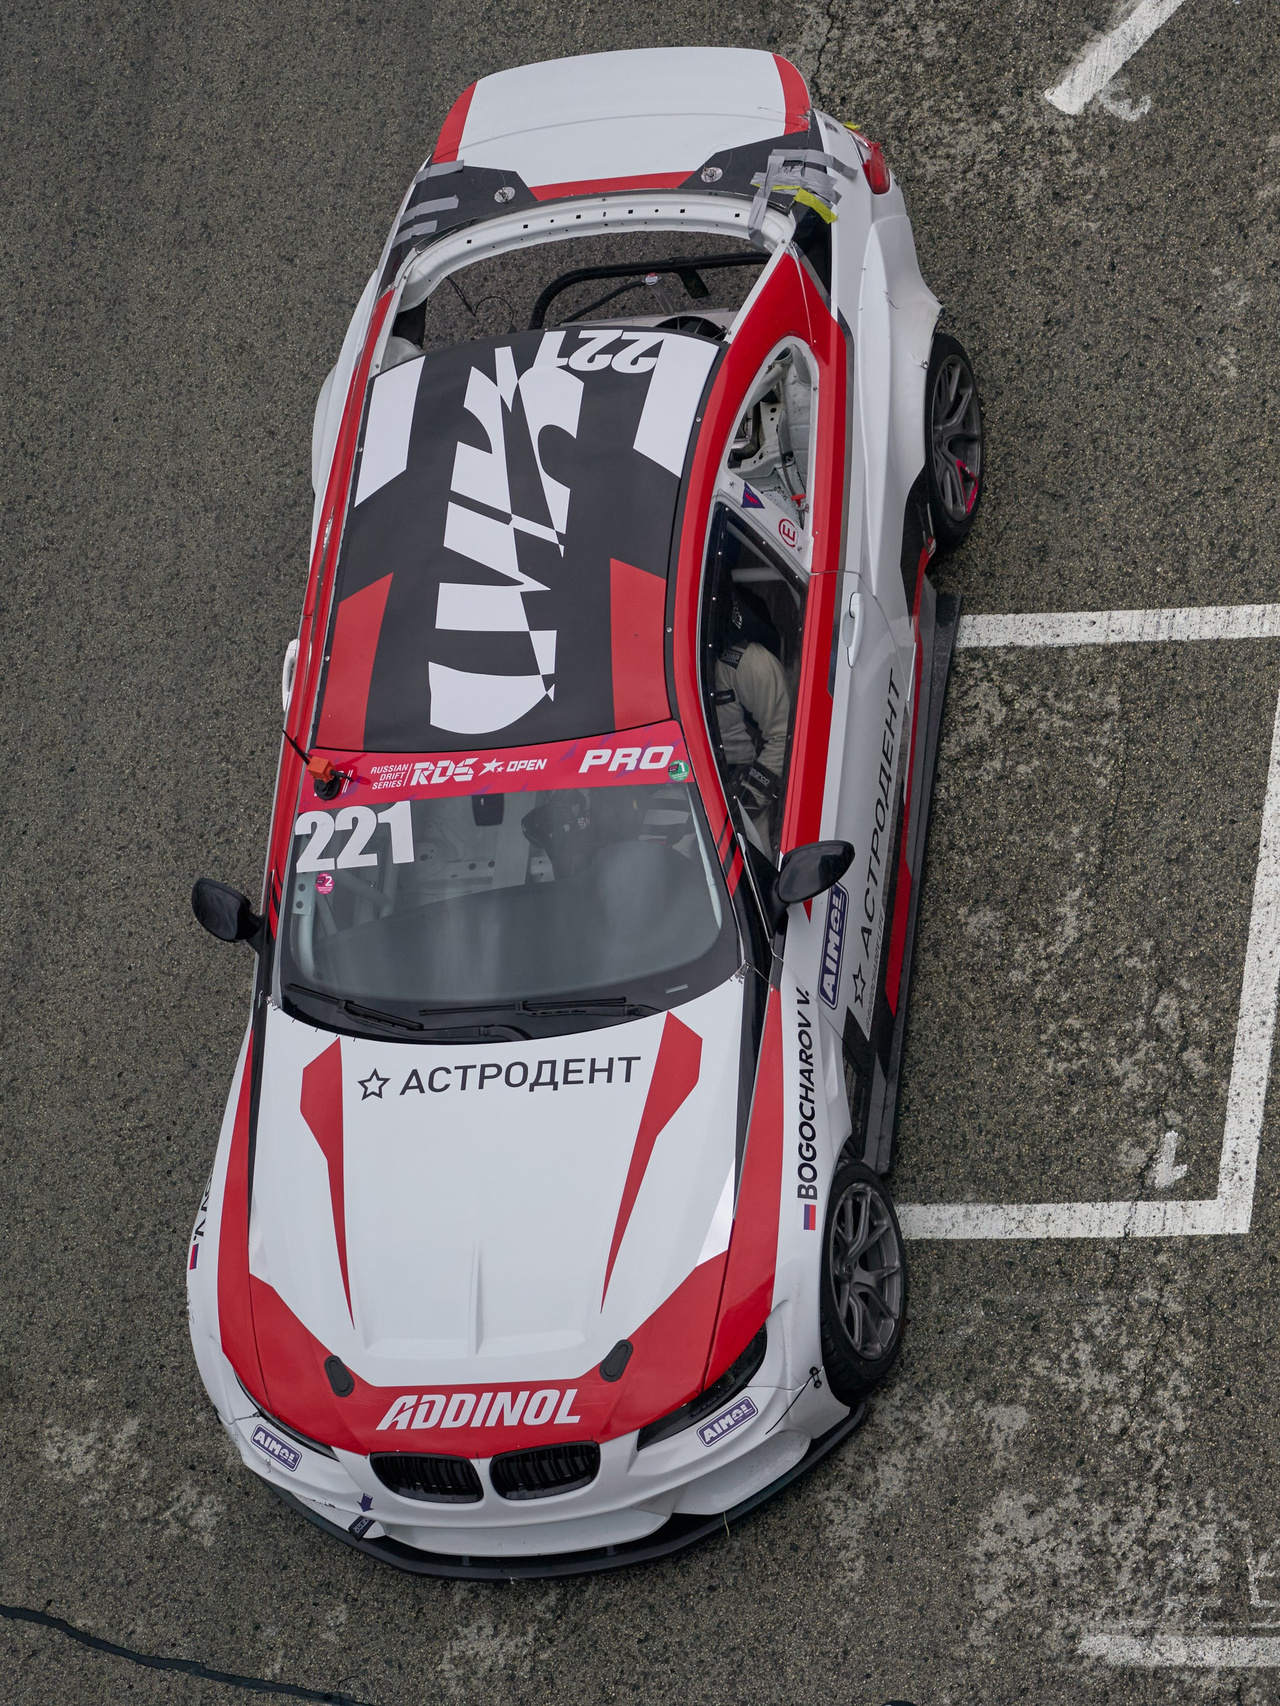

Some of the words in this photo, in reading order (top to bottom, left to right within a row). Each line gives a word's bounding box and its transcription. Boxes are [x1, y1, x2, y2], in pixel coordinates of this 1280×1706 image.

[533, 329, 665, 374] 221
[371, 764, 409, 774] RUSSIAN
[380, 772, 405, 781] DRIFT
[506, 758, 547, 773] OPEN
[578, 745, 674, 774] PRO
[372, 780, 402, 790] SERIES
[861, 667, 900, 959] АСТРОДЕНТ
[295, 800, 415, 873] 221
[821, 892, 844, 1002] AIMOL
[795, 986, 811, 1006] V.
[400, 1056, 641, 1096] АСТРОДЕНТ
[797, 1010, 819, 1200] BOGOCHAROV
[376, 1389, 581, 1431] ADDINOL
[703, 1401, 753, 1445] AIMOL
[253, 1430, 300, 1467] AIMOL
